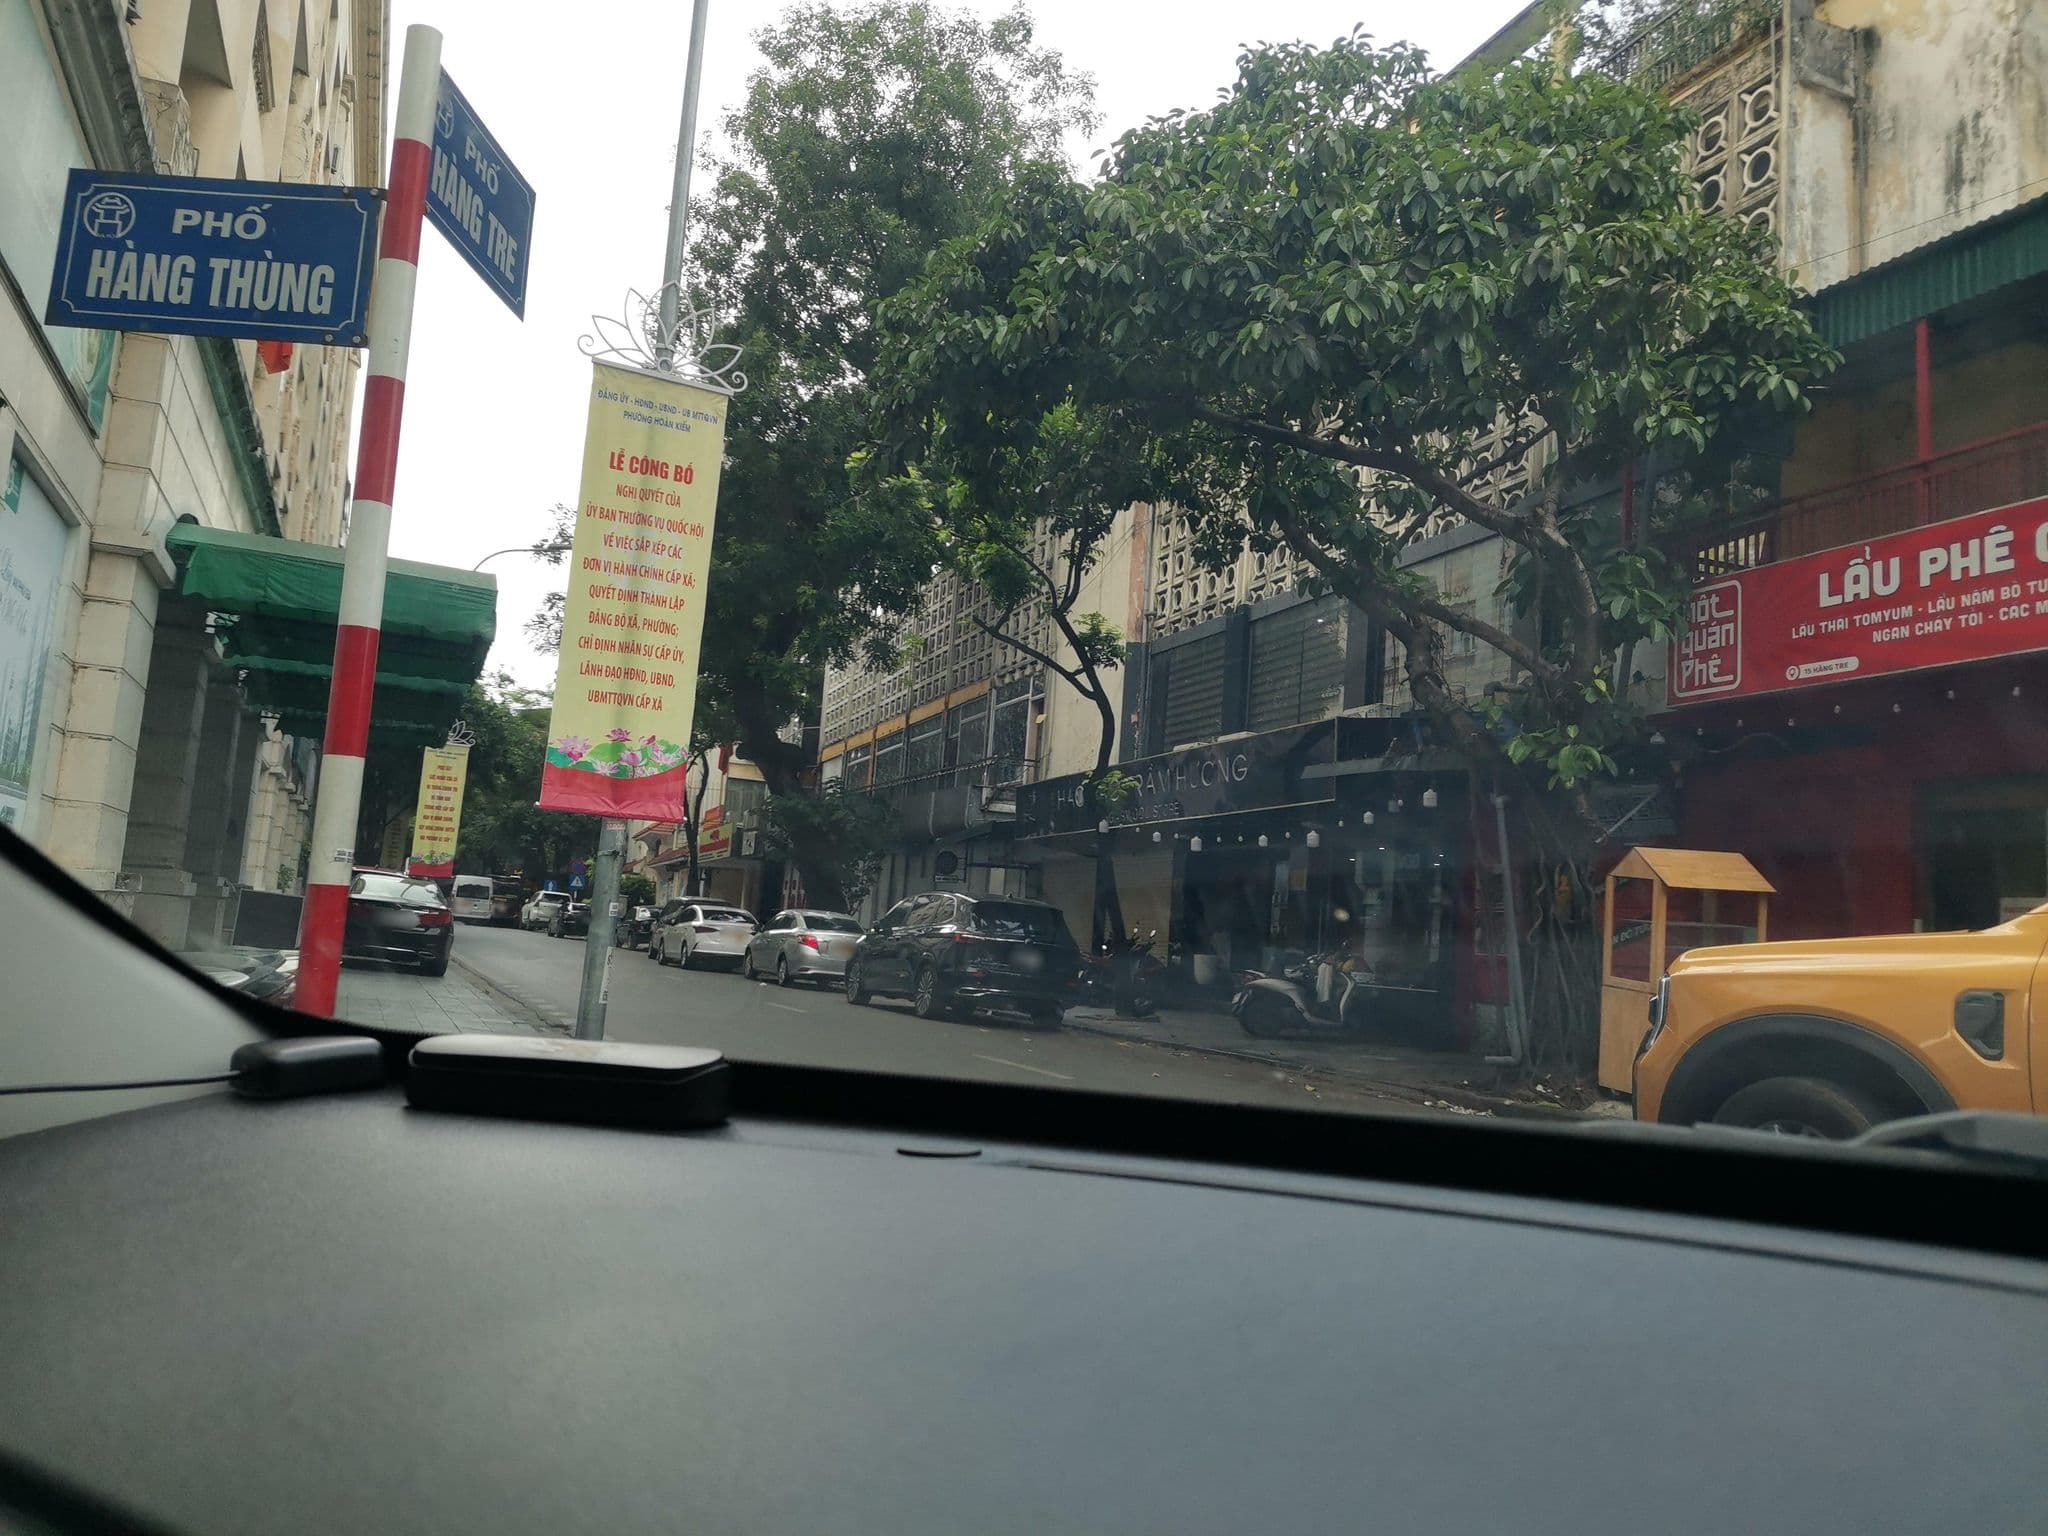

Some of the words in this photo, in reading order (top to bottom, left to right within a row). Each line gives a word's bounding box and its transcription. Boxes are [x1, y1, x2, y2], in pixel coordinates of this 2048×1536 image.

[464, 136, 500, 195] PHỐ
[172, 203, 272, 240] PHỐ
[431, 145, 484, 245] HÀNG
[487, 211, 518, 284] TRE
[85, 239, 196, 305] HÀNG
[208, 250, 335, 315] THÙNG
[597, 387, 618, 402] ĐẢNG
[620, 391, 629, 404] ỦY
[659, 403, 677, 414] UBND
[682, 408, 691, 417] UB
[623, 410, 652, 425] PHƯỜNG
[654, 416, 674, 429] HOÀN
[675, 420, 691, 432] KIẾM
[608, 447, 625, 472] LỄ
[629, 455, 669, 479] CÔNG
[673, 462, 694, 485] BỐ
[616, 484, 637, 502] NGHỊ
[639, 488, 664, 503] QUYẾT
[665, 490, 681, 508] CỦA
[586, 501, 598, 517] ỦY
[599, 506, 616, 522] BAN
[619, 510, 653, 527] THƯỜNG
[654, 516, 665, 533] VỤ
[666, 518, 688, 535] QUỐC
[690, 523, 704, 540] HỘI
[603, 531, 614, 547] VỀ
[615, 535, 633, 553] VIỆC
[635, 535, 651, 552] SẮP
[652, 540, 666, 556] XẾP
[667, 545, 682, 559] CÁC
[583, 557, 600, 573] ĐƠN
[603, 560, 612, 576] VỊ
[613, 560, 637, 576] HÀNH
[639, 564, 664, 581] CHÍNH
[665, 569, 681, 585] CẤP
[1818, 545, 1901, 608] LẨU
[1919, 525, 2015, 588] PHÊ
[589, 583, 616, 599] QUYẾT
[617, 588, 638, 605] ĐỊNH
[640, 591, 667, 609] THÀNH
[669, 595, 685, 613] LẬP
[589, 608, 612, 626] ĐẢNG
[614, 613, 625, 631] BỘ
[1853, 605, 1913, 627] TOMYUM
[1872, 625, 1910, 643] NGAN
[1915, 615, 1952, 636] CHÁY
[1999, 602, 2030, 621] CÁC
[578, 633, 593, 649] CHỈ
[594, 638, 616, 654] ĐỊNH
[618, 640, 641, 656] NHÂN
[643, 643, 654, 661] SỰ
[655, 645, 671, 660] CẤP
[580, 660, 605, 677] LÃNH
[605, 665, 622, 682] ĐẠO
[623, 667, 648, 685] HĐND,
[650, 671, 676, 688] UBND,
[1813, 664, 1834, 674] HÀNG
[1836, 661, 1849, 670] TRE
[588, 690, 634, 707] UBMTTQVN
[635, 693, 651, 709] CẤP
[652, 696, 663, 711] XÃ
